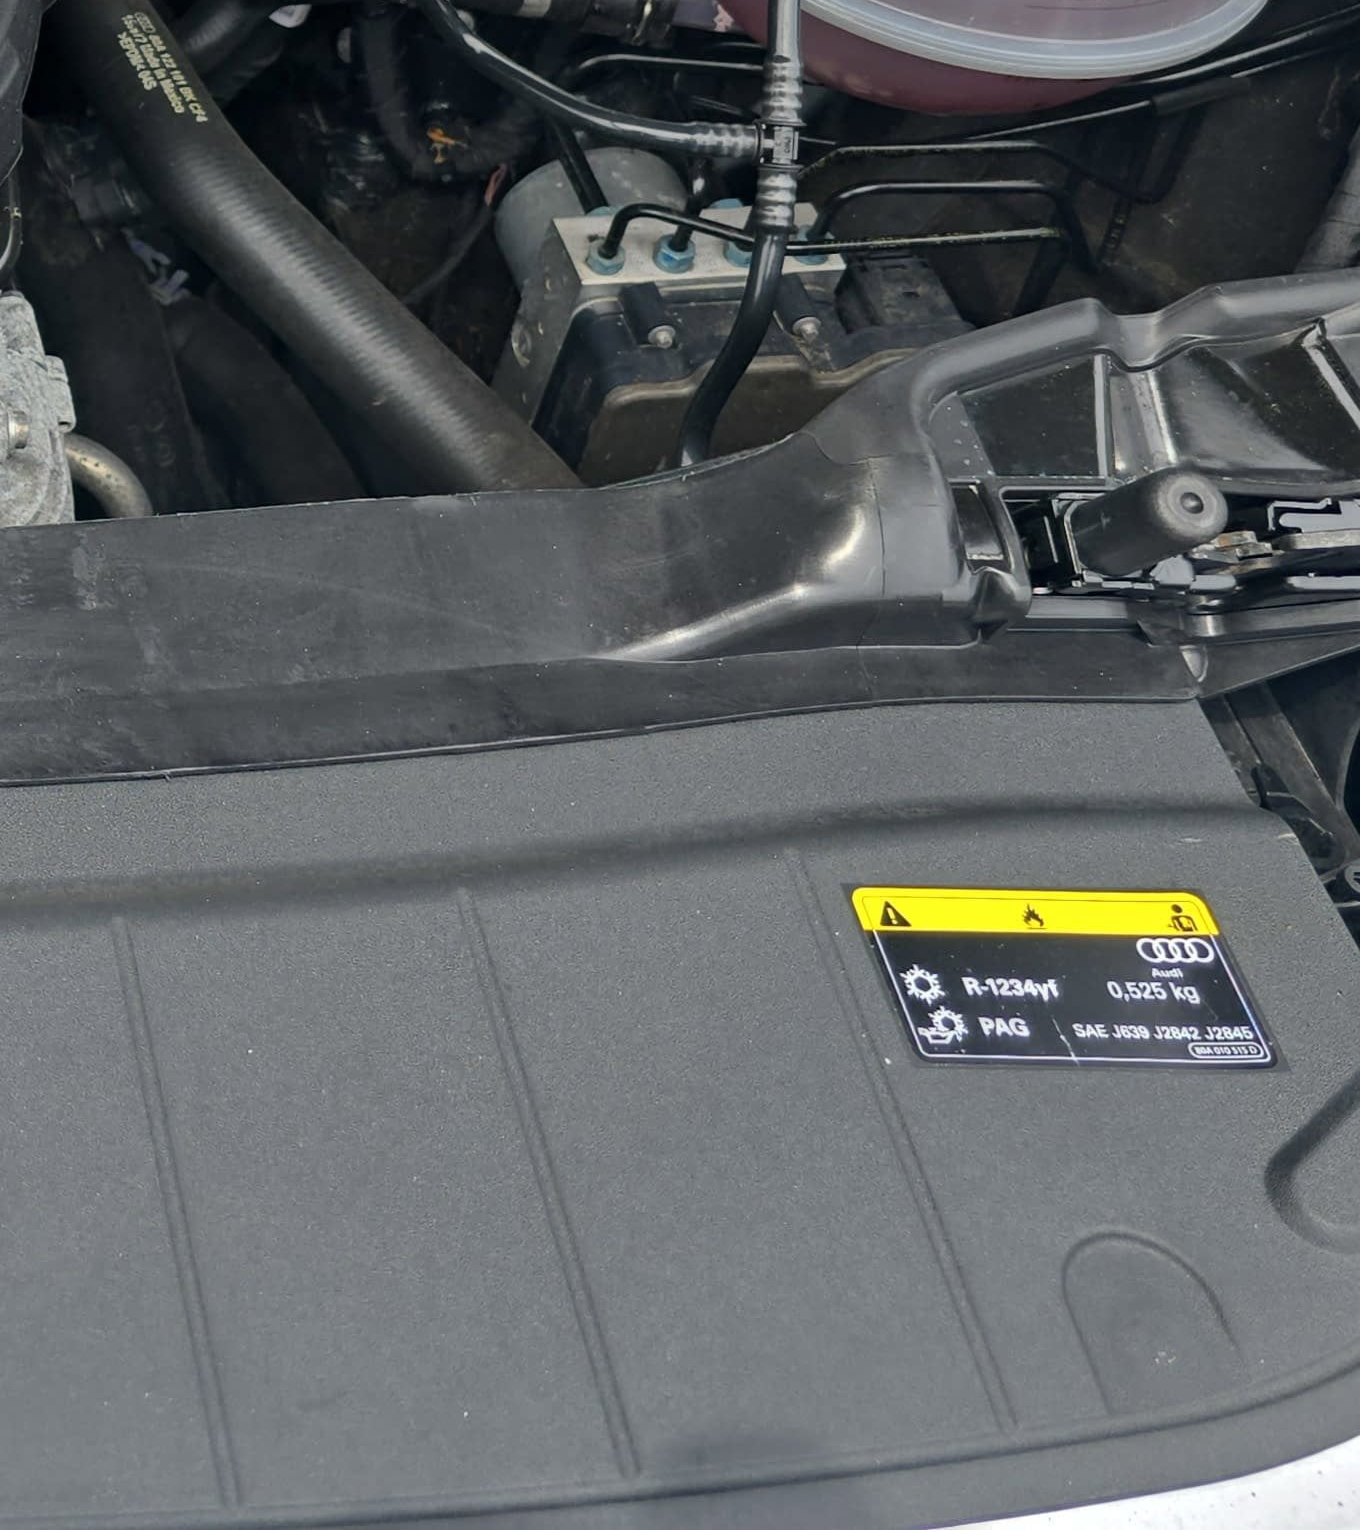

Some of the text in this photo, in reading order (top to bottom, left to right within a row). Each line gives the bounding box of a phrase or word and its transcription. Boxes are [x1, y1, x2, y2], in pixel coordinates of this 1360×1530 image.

[1151, 967, 1183, 978] Audi
[961, 977, 1059, 1001] R-1234yf
[1106, 981, 1200, 1004] 0,525 kg
[978, 1017, 1030, 1037] PAG
[1072, 1023, 1254, 1041] SAE J639 J2842 J2845
